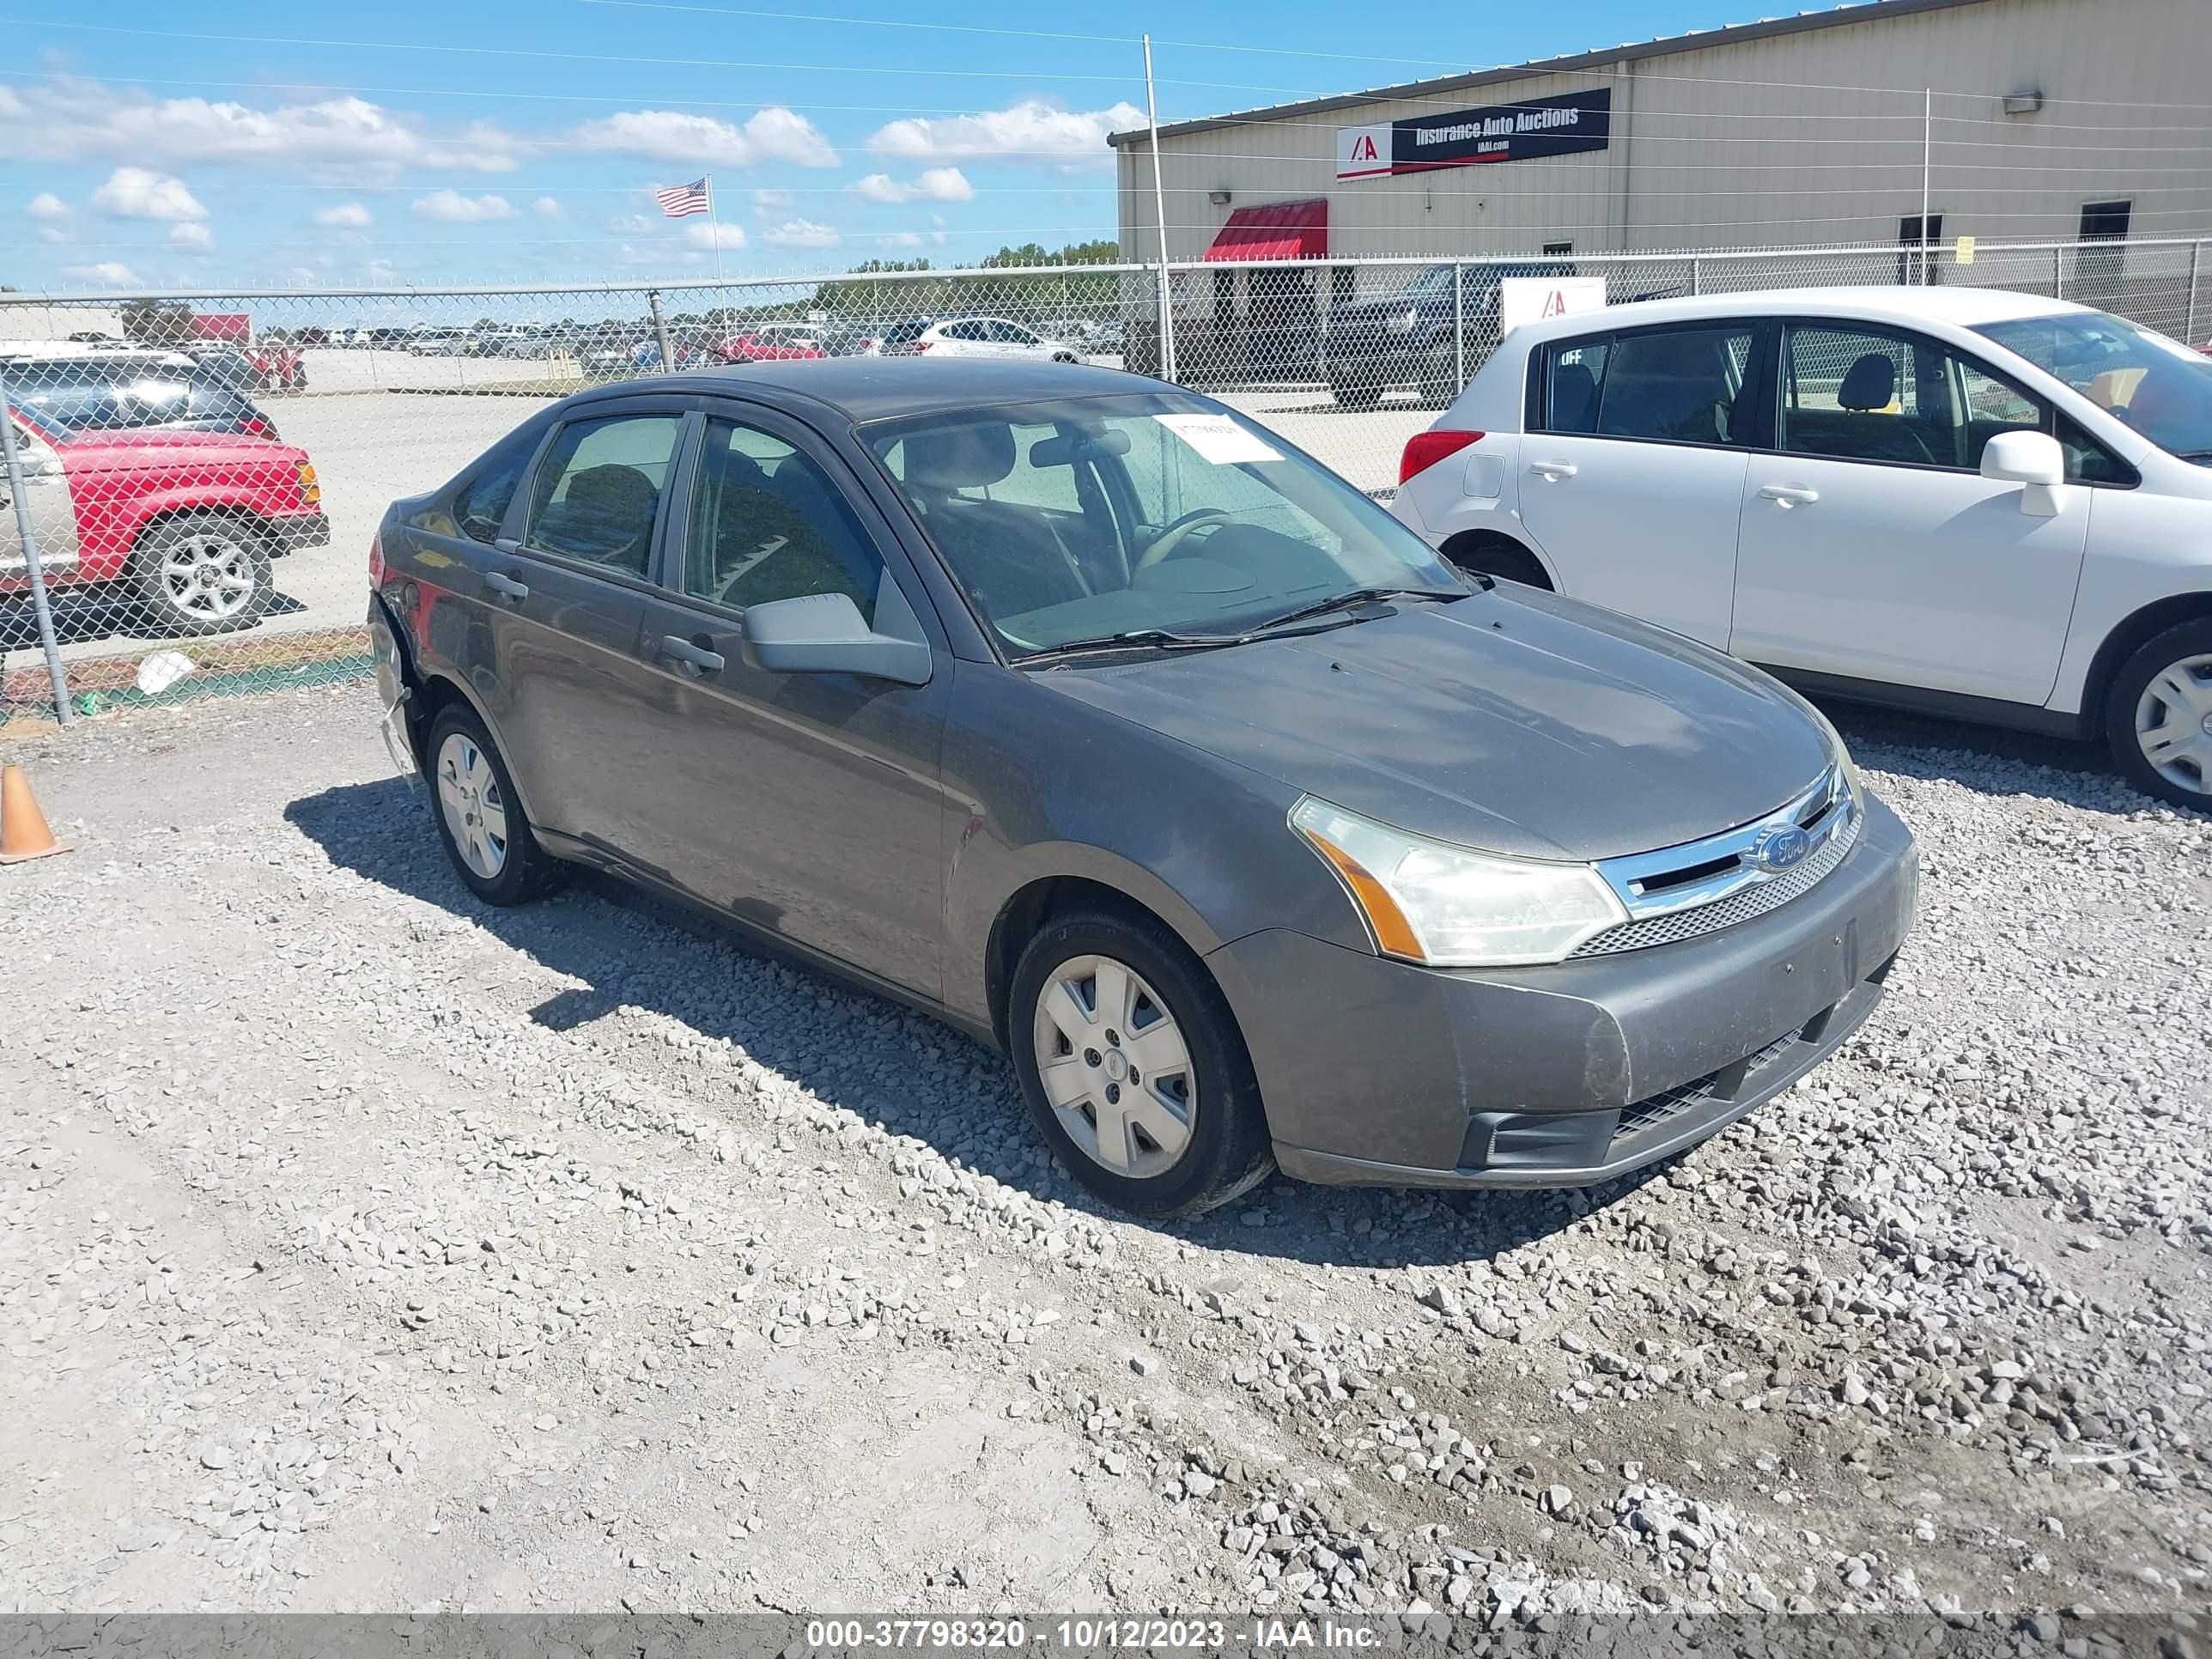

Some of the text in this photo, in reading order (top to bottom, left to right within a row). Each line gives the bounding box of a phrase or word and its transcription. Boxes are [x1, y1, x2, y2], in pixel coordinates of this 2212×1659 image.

[1416, 108, 1579, 146] Insurance Auto Auctions
[1778, 833, 1806, 863] Ford
